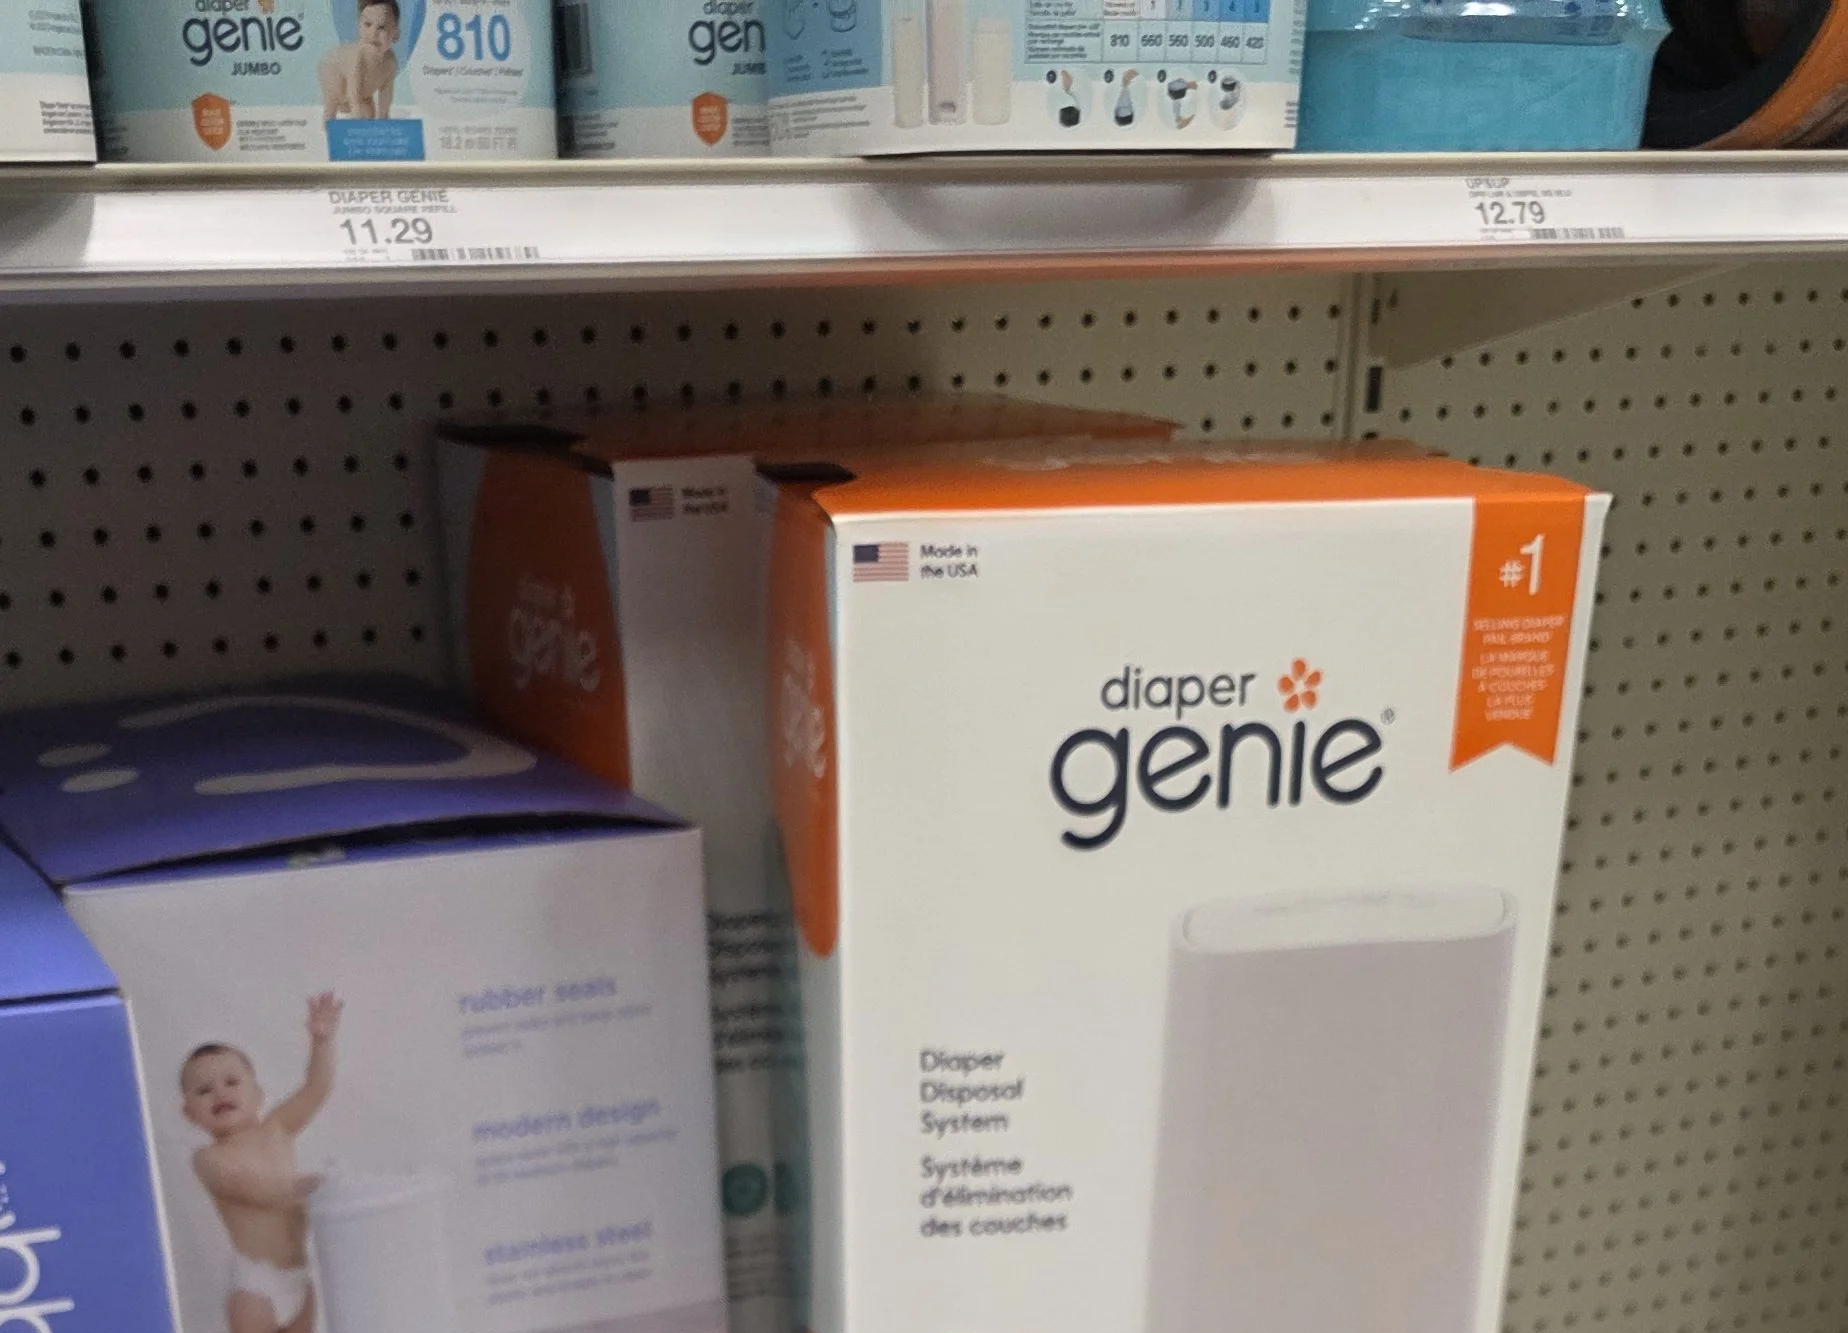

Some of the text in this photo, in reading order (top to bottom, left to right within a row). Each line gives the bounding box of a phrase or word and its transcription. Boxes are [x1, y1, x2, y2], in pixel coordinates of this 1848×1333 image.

[182, 16, 304, 66] genie
[436, 12, 511, 61] 810
[688, 19, 766, 66] gen
[1169, 34, 1190, 48] 560
[232, 62, 281, 75] JUMBO
[329, 189, 449, 204] DIAPER GENIE
[1474, 201, 1545, 225] 12.79
[339, 217, 433, 245] 11.29
[920, 543, 978, 559] Made in
[1499, 532, 1545, 596] #1
[920, 563, 979, 580] the USA
[1101, 664, 1257, 718] diaper
[1049, 717, 1384, 852] genie
[457, 985, 546, 1014] rubber
[919, 1048, 1005, 1077] Diaper
[919, 1075, 1026, 1108] Disposal
[471, 1098, 660, 1142] modern design
[920, 1110, 1009, 1140] System
[920, 1156, 1023, 1184] Système
[919, 1181, 1073, 1208] d'élimination
[920, 1213, 1068, 1237] des couches
[483, 1219, 652, 1265] stainless steel
